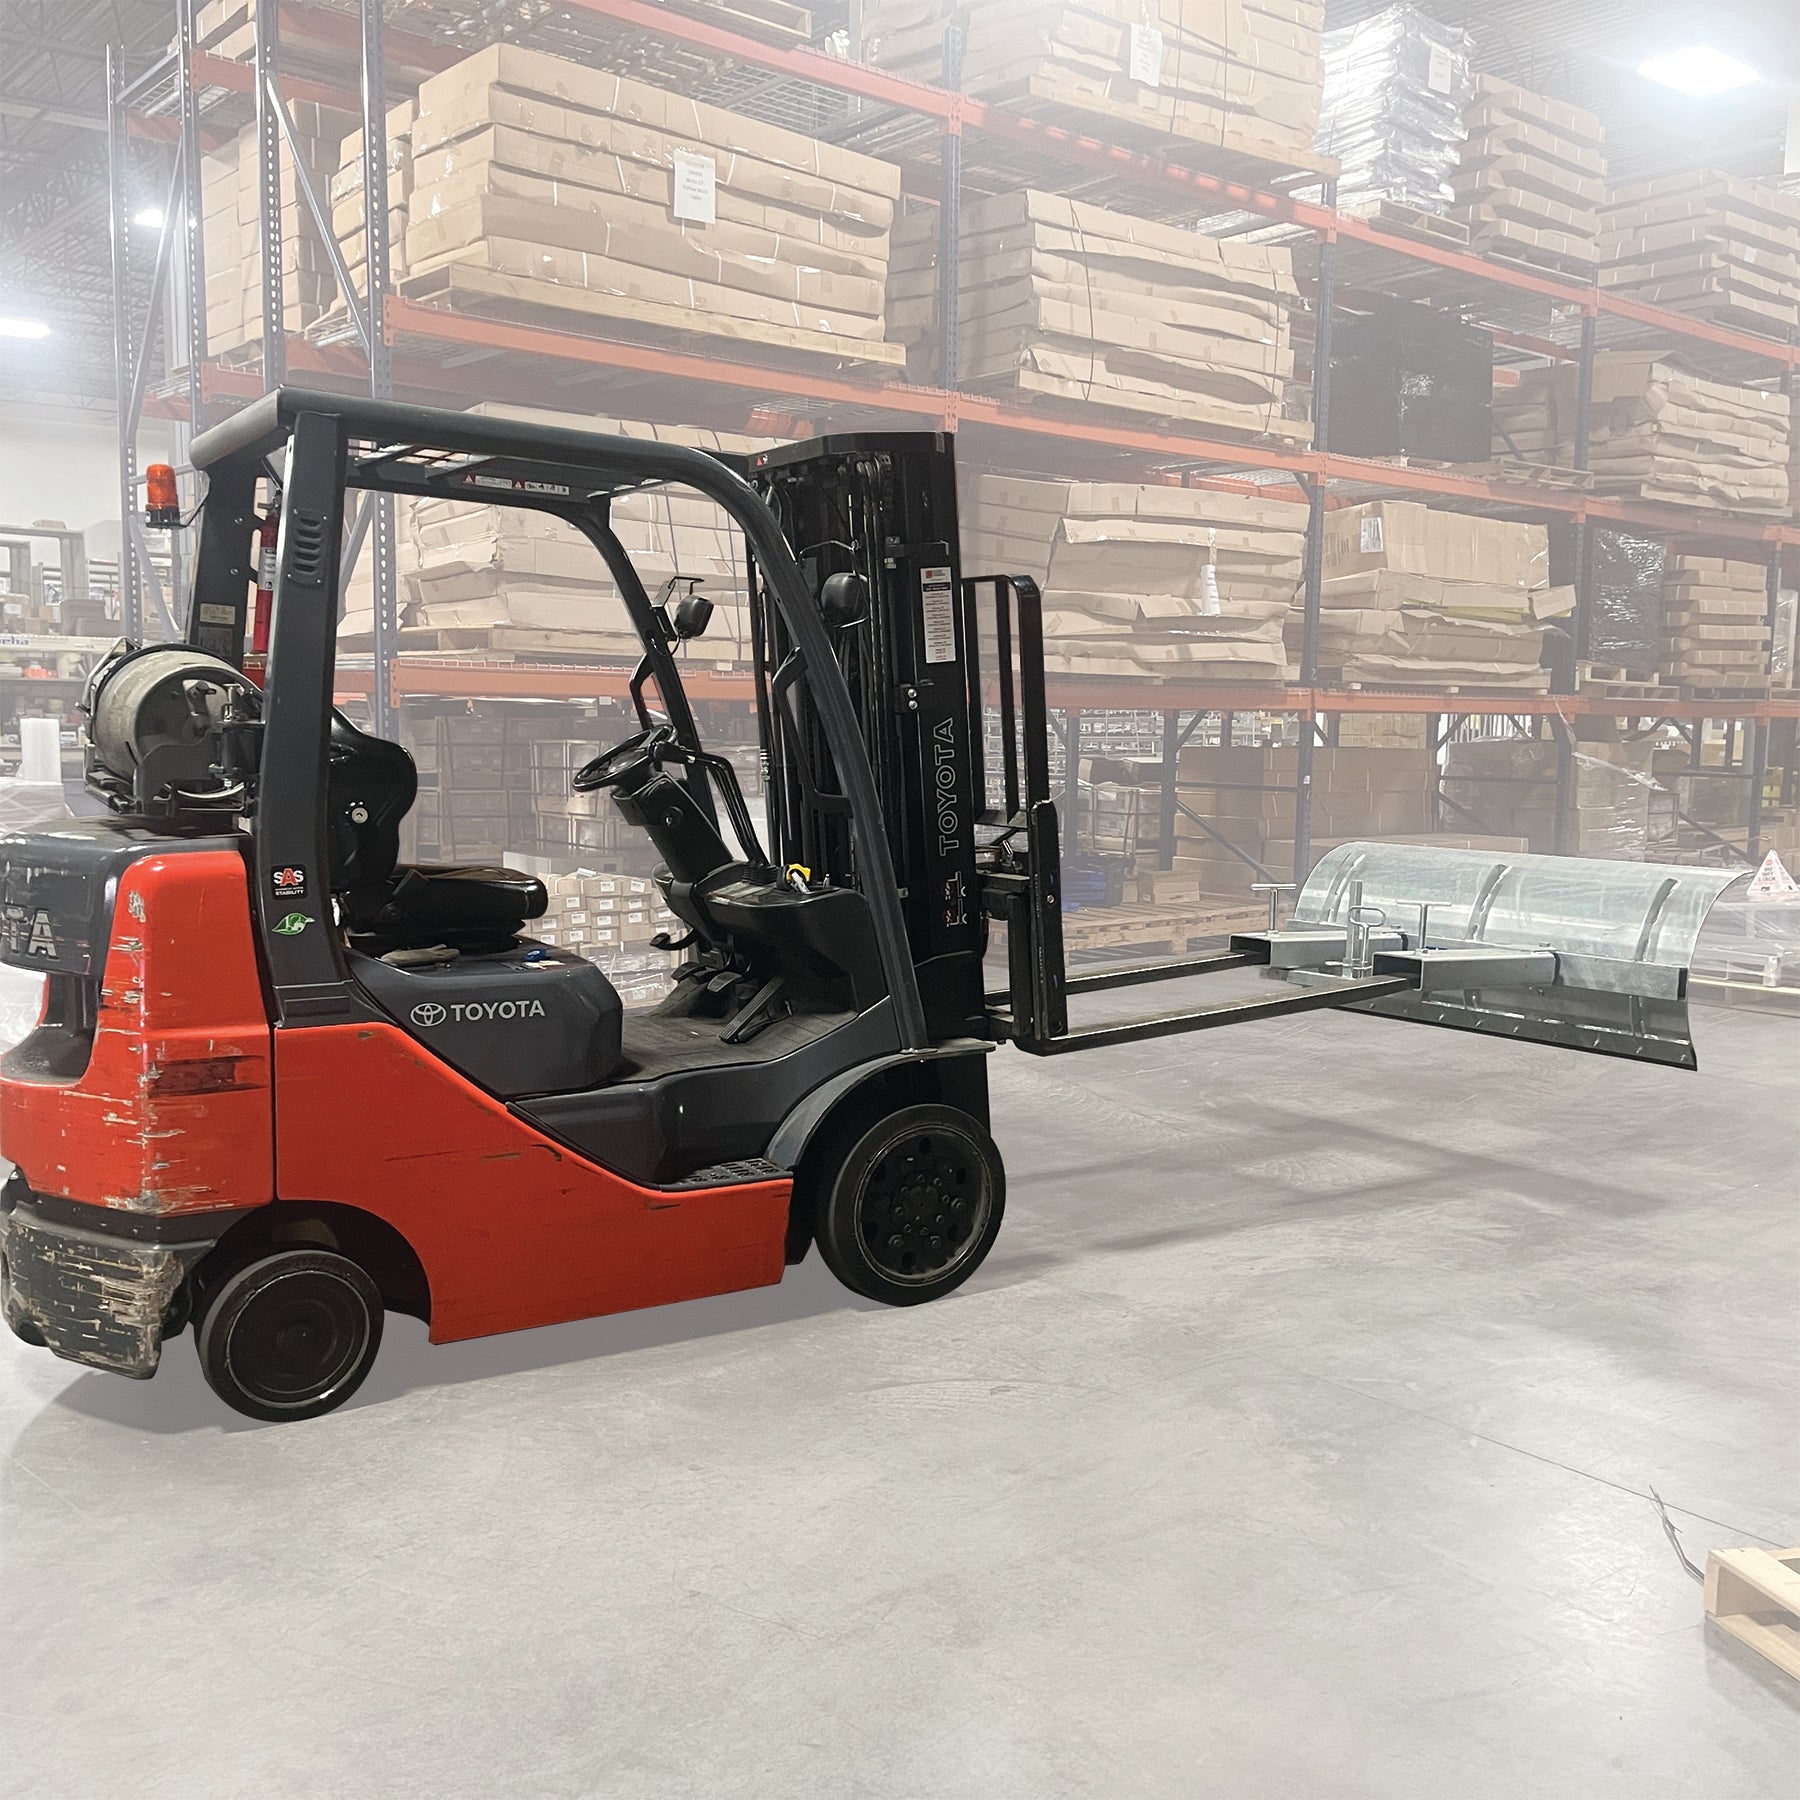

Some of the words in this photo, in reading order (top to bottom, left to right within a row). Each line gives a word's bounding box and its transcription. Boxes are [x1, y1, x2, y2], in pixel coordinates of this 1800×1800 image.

[933, 717, 959, 856] TOYOTA
[273, 868, 304, 886] SAS
[0, 907, 57, 957] TA
[450, 1000, 545, 1021] TOYOTA
